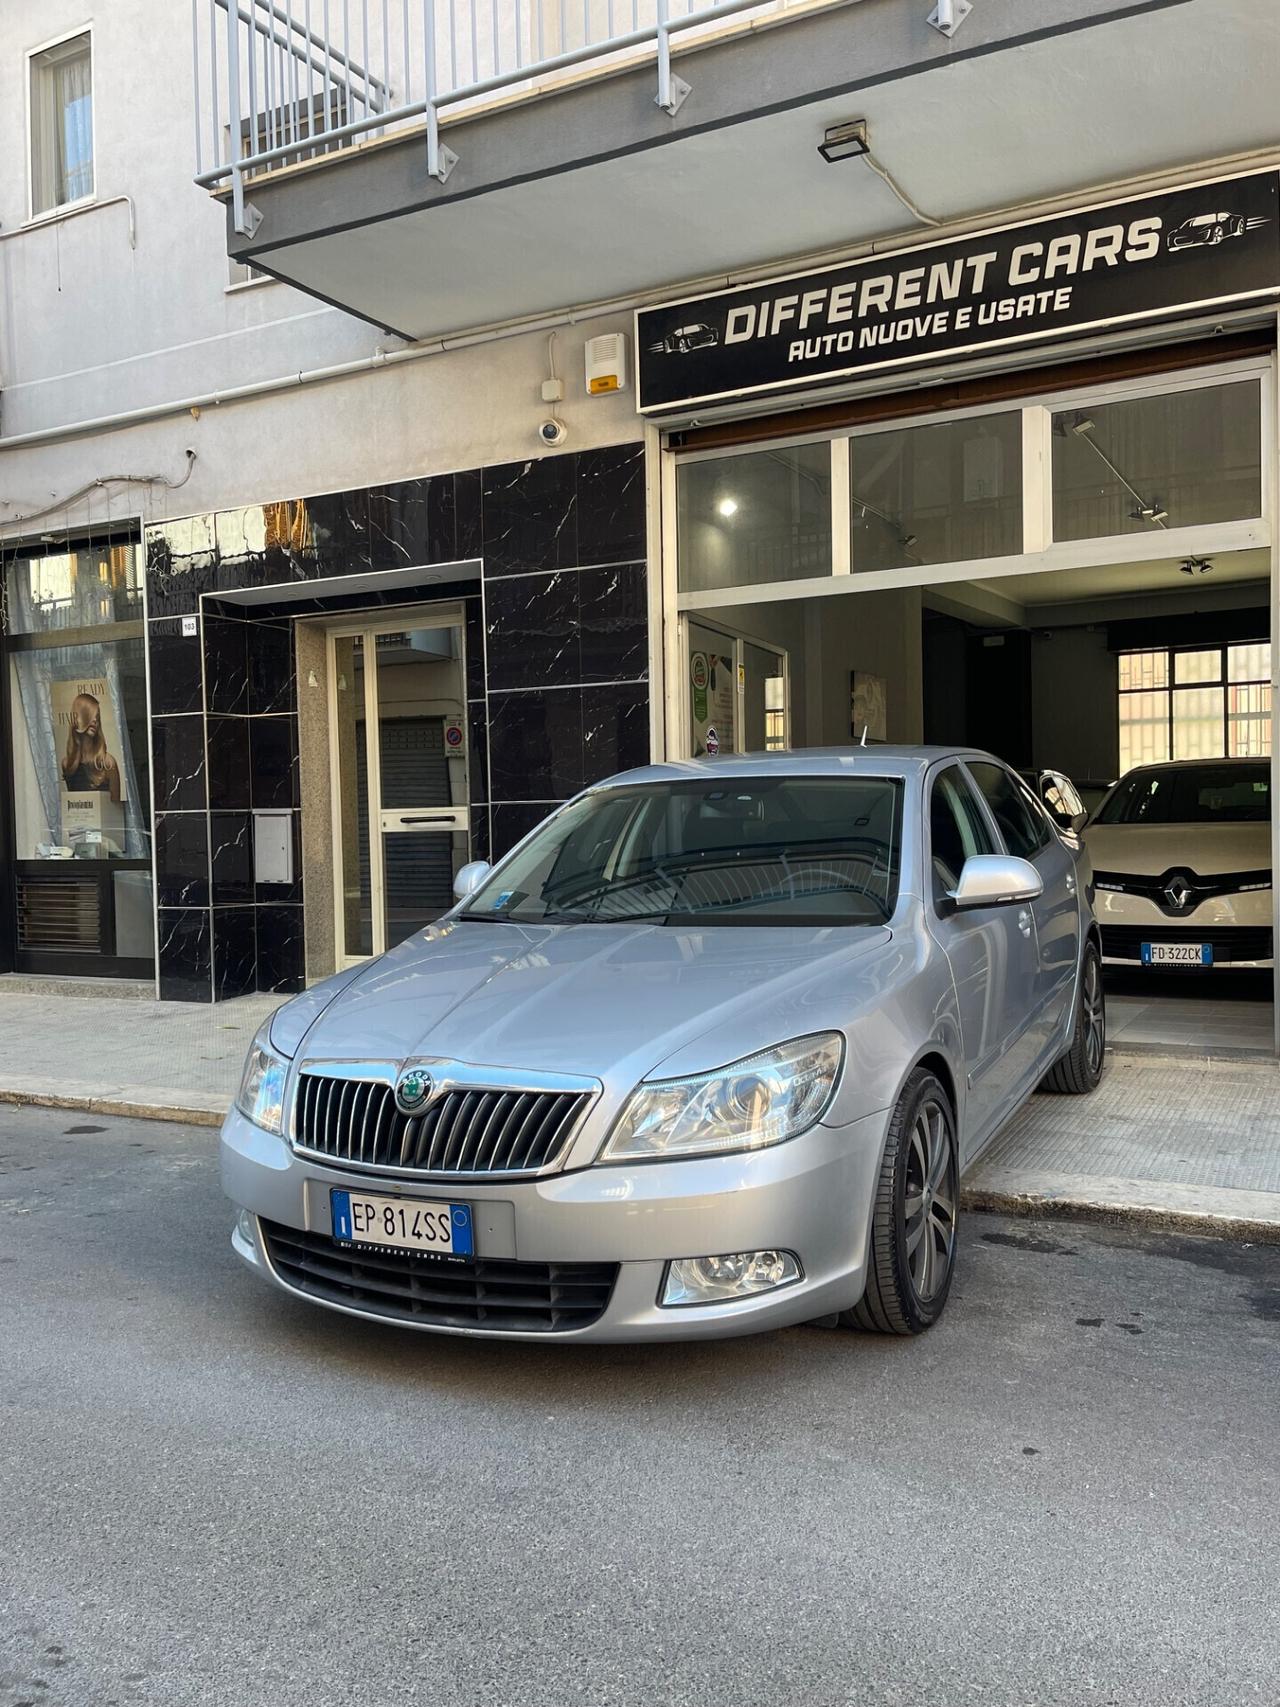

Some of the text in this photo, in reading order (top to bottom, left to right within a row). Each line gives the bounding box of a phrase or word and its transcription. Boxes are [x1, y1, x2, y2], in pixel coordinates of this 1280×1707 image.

[724, 216, 1163, 345] DIFFERENT CARS
[788, 286, 1073, 362] AUTO NUOVE E USATE
[77, 683, 105, 696] READY
[1151, 947, 1201, 960] FD 322CK
[352, 1202, 451, 1243] EP 814SS
